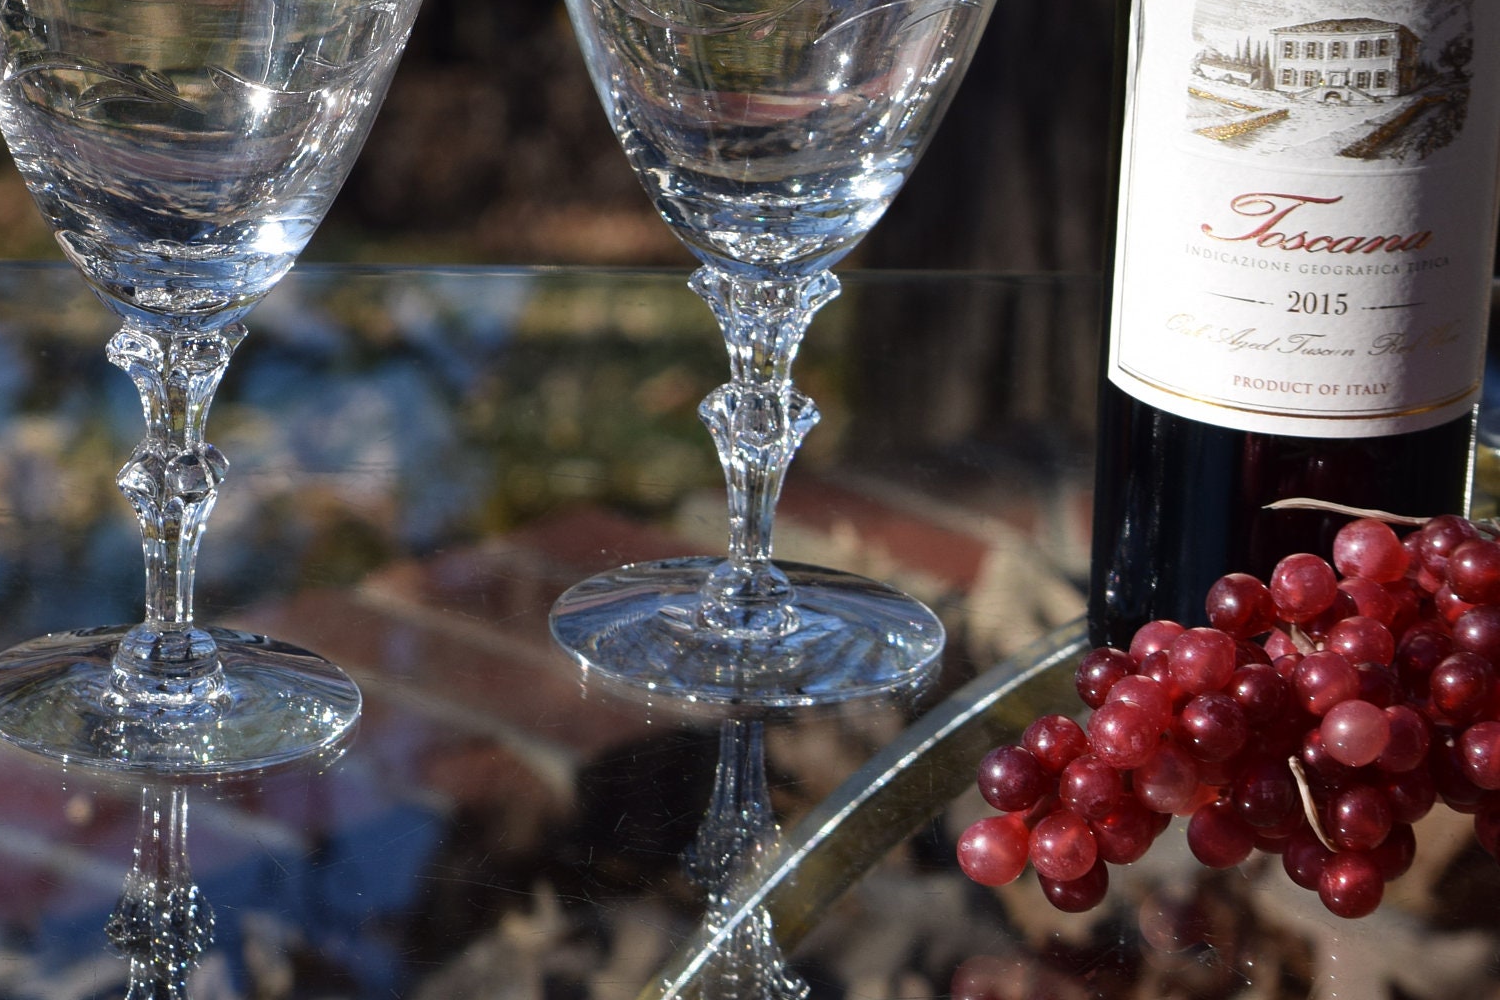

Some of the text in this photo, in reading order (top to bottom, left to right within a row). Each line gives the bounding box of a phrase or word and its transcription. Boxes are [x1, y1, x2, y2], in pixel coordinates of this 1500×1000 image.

[1201, 192, 1434, 255] Toscana
[1185, 243, 1450, 276] INDICAZIONE GEOGRAFICA TIPICA
[1287, 290, 1349, 316] 2015
[1233, 375, 1391, 396] PRODUCT OF ITALY
